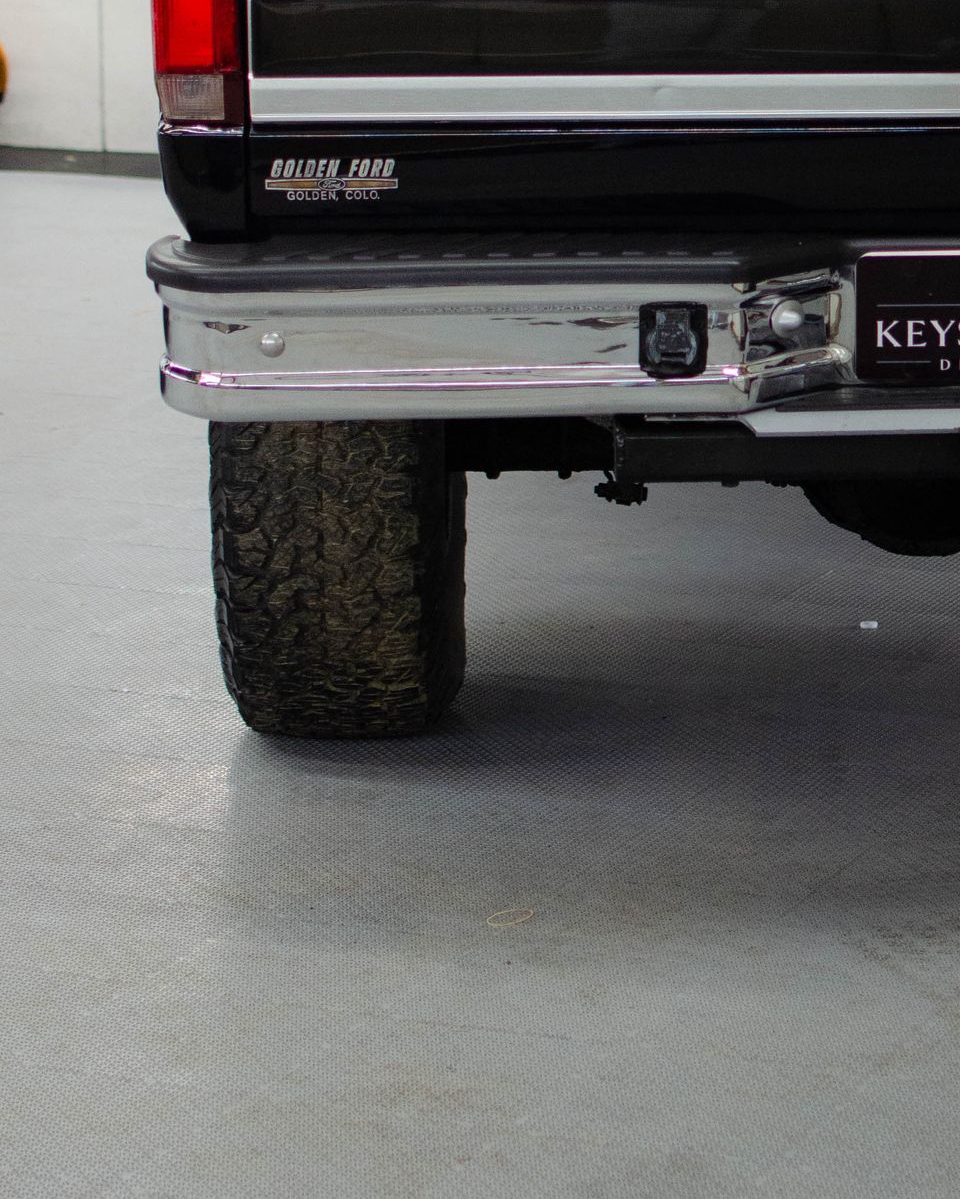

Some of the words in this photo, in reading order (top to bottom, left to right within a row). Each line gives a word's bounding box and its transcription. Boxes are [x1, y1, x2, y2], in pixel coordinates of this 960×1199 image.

[270, 159, 341, 178] GOLDEN
[349, 158, 396, 177] FORD
[286, 190, 339, 201] GOLDEN,
[345, 190, 381, 200] COLO.
